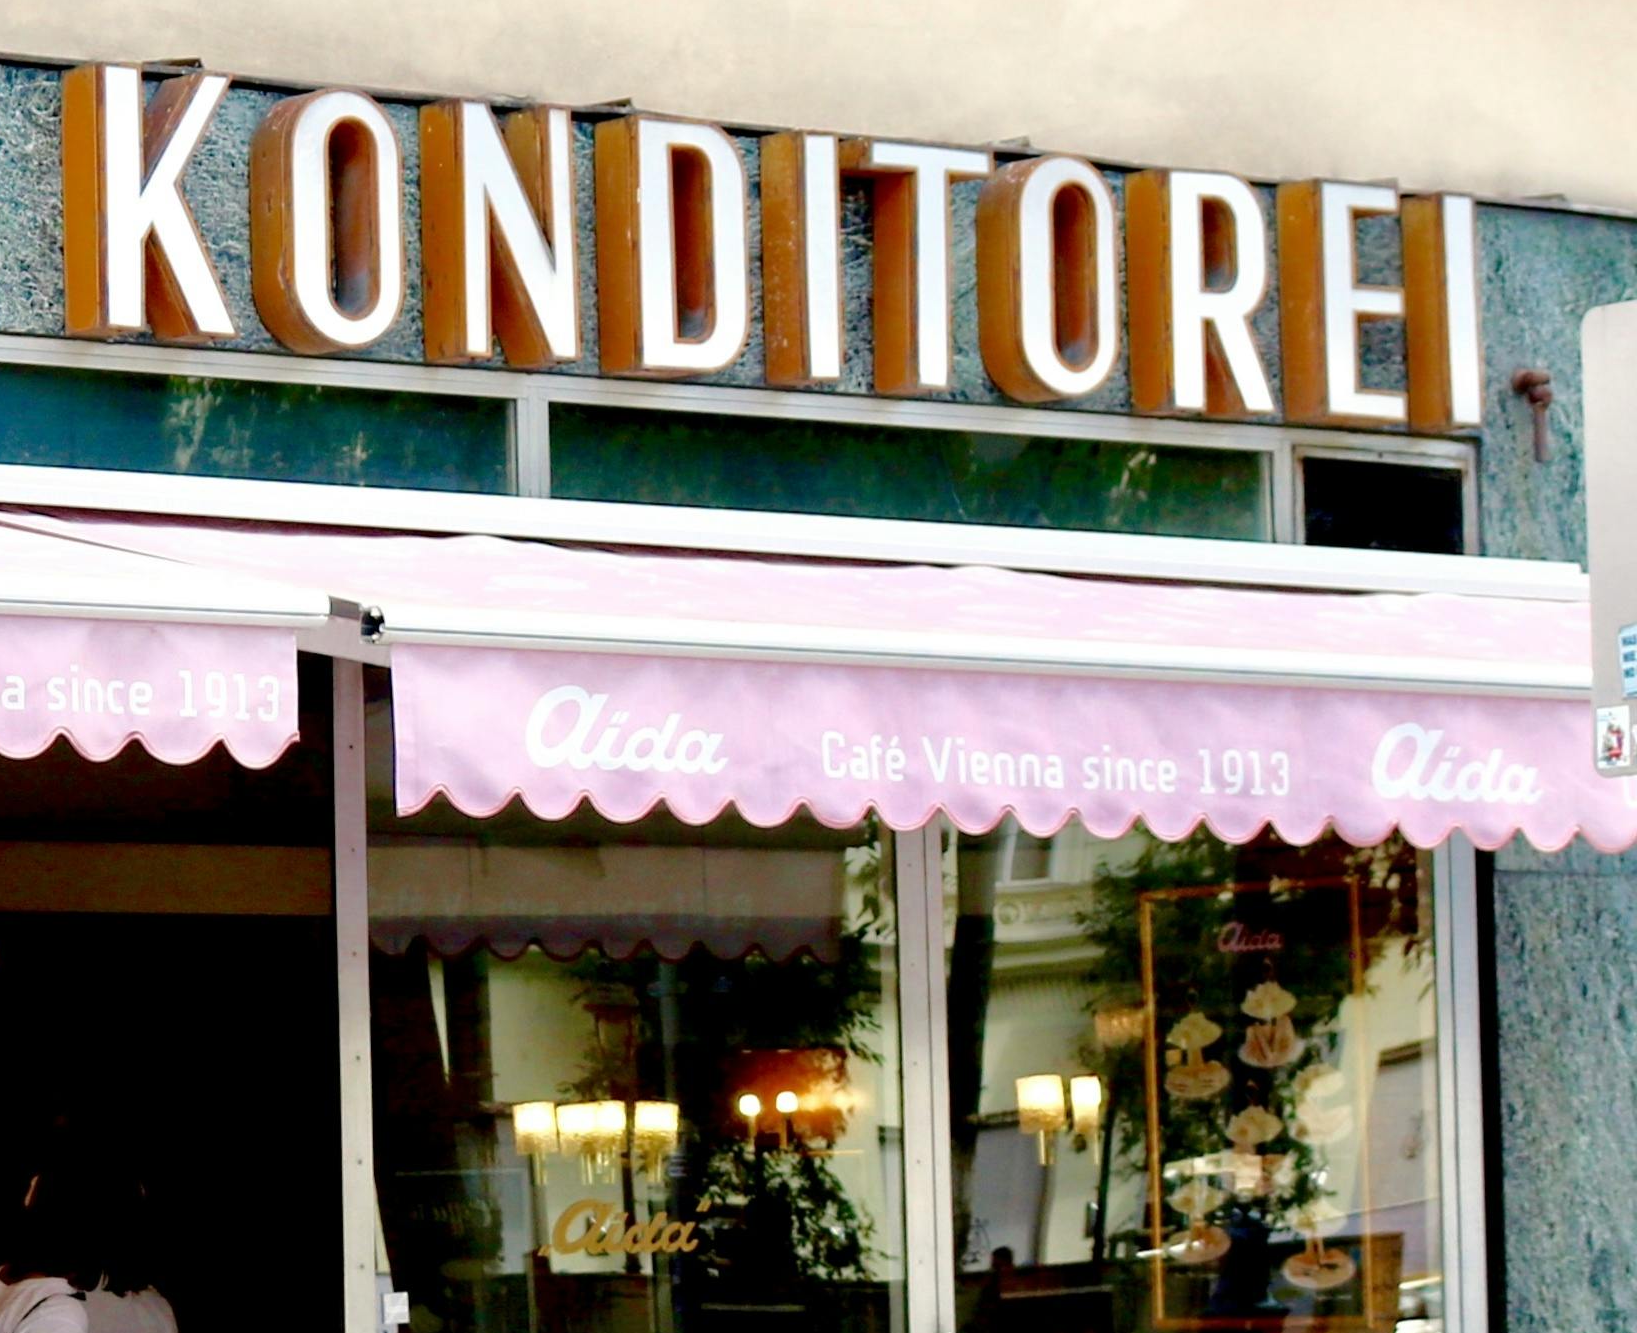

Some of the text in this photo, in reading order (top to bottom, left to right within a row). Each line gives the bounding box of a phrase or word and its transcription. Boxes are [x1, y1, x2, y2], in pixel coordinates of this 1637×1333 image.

[62, 64, 1484, 430] KONDITOREI
[46, 664, 154, 717] since
[178, 669, 281, 723] 1913
[821, 730, 1291, 797] Café Vienna since 1913
